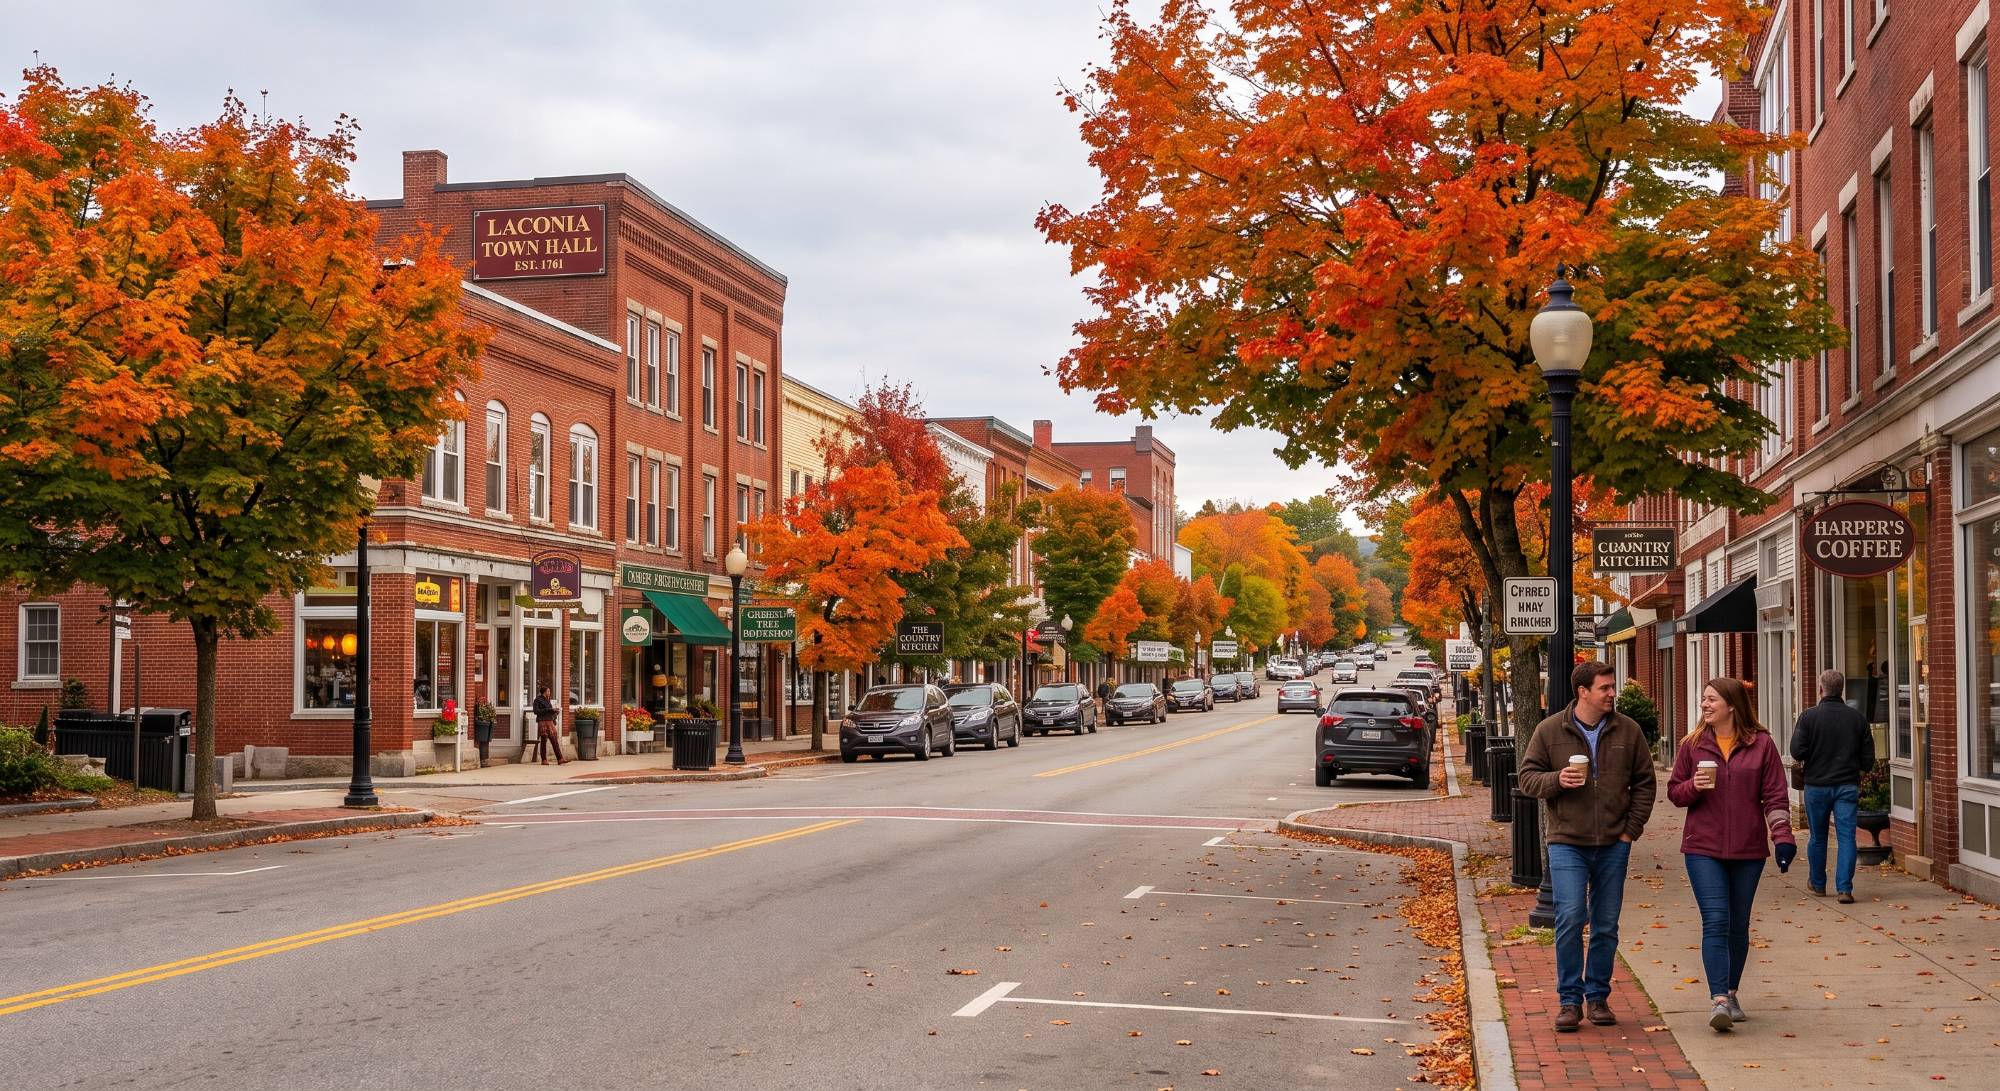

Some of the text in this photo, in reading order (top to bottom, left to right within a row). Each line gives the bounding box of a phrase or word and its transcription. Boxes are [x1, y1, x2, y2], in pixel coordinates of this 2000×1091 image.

[488, 215, 591, 236] LACONIA
[481, 236, 598, 258] TOWN HALL
[514, 259, 563, 271] EST. 1761
[1814, 520, 1905, 536] HARPER'S
[1816, 540, 1903, 558] COFFEE
[756, 620, 780, 628] TREE
[911, 626, 929, 634] THE
[899, 634, 941, 642] COUNTRY
